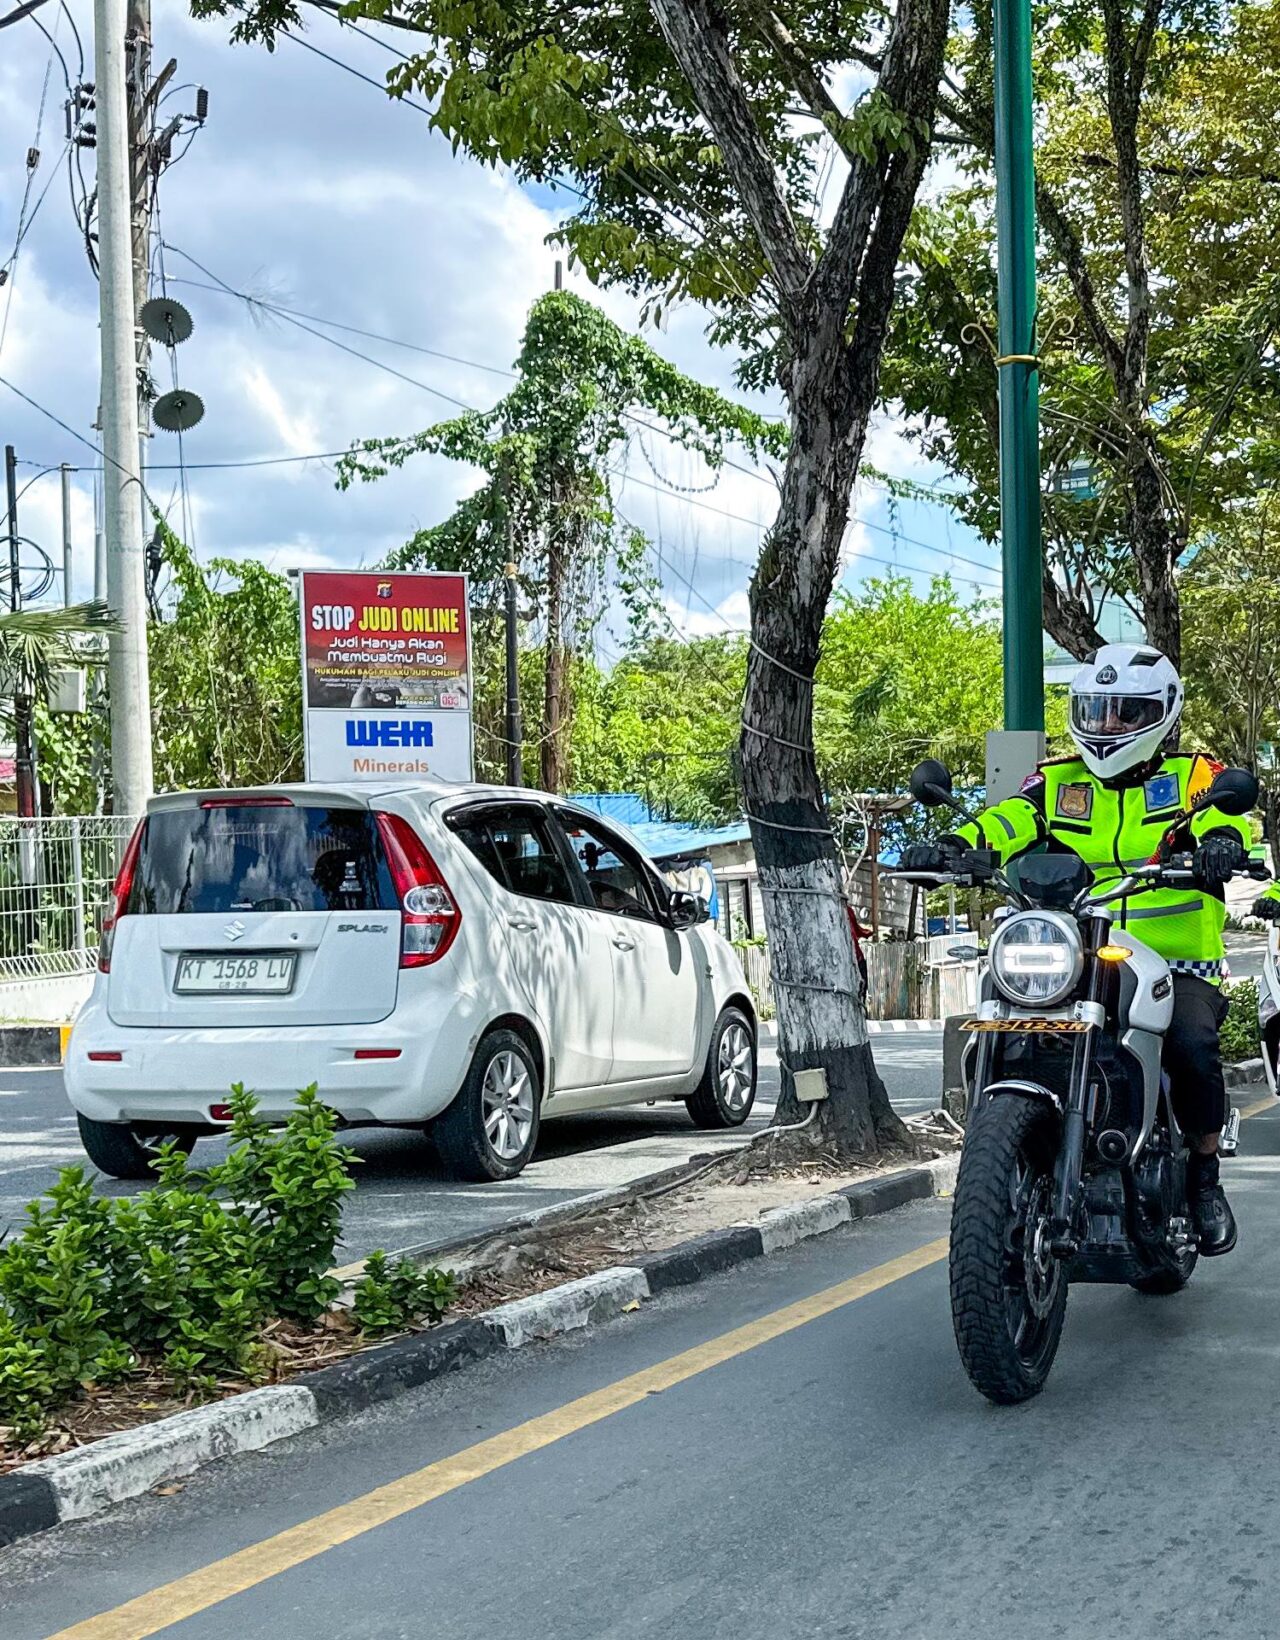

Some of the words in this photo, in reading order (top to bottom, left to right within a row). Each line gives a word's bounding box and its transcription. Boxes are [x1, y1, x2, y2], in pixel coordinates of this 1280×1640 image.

[311, 605, 355, 631] STOP
[358, 606, 398, 632] JUDI
[401, 607, 460, 633] ONLINE
[329, 636, 359, 648] Judi
[361, 637, 406, 650] Hanya
[408, 638, 444, 649] Akan
[327, 651, 413, 663] Membuatmu
[416, 652, 447, 666] Rugi
[314, 668, 356, 676] HUKUMAN
[357, 668, 376, 676] BAGI
[411, 669, 429, 677] JUDI
[430, 669, 460, 677] ONLINE
[345, 720, 434, 747] WEIR
[353, 758, 429, 773] Minerals
[337, 924, 389, 934] SPLASH
[181, 960, 207, 979] KT
[213, 959, 258, 979] 1568
[266, 959, 291, 979] LV
